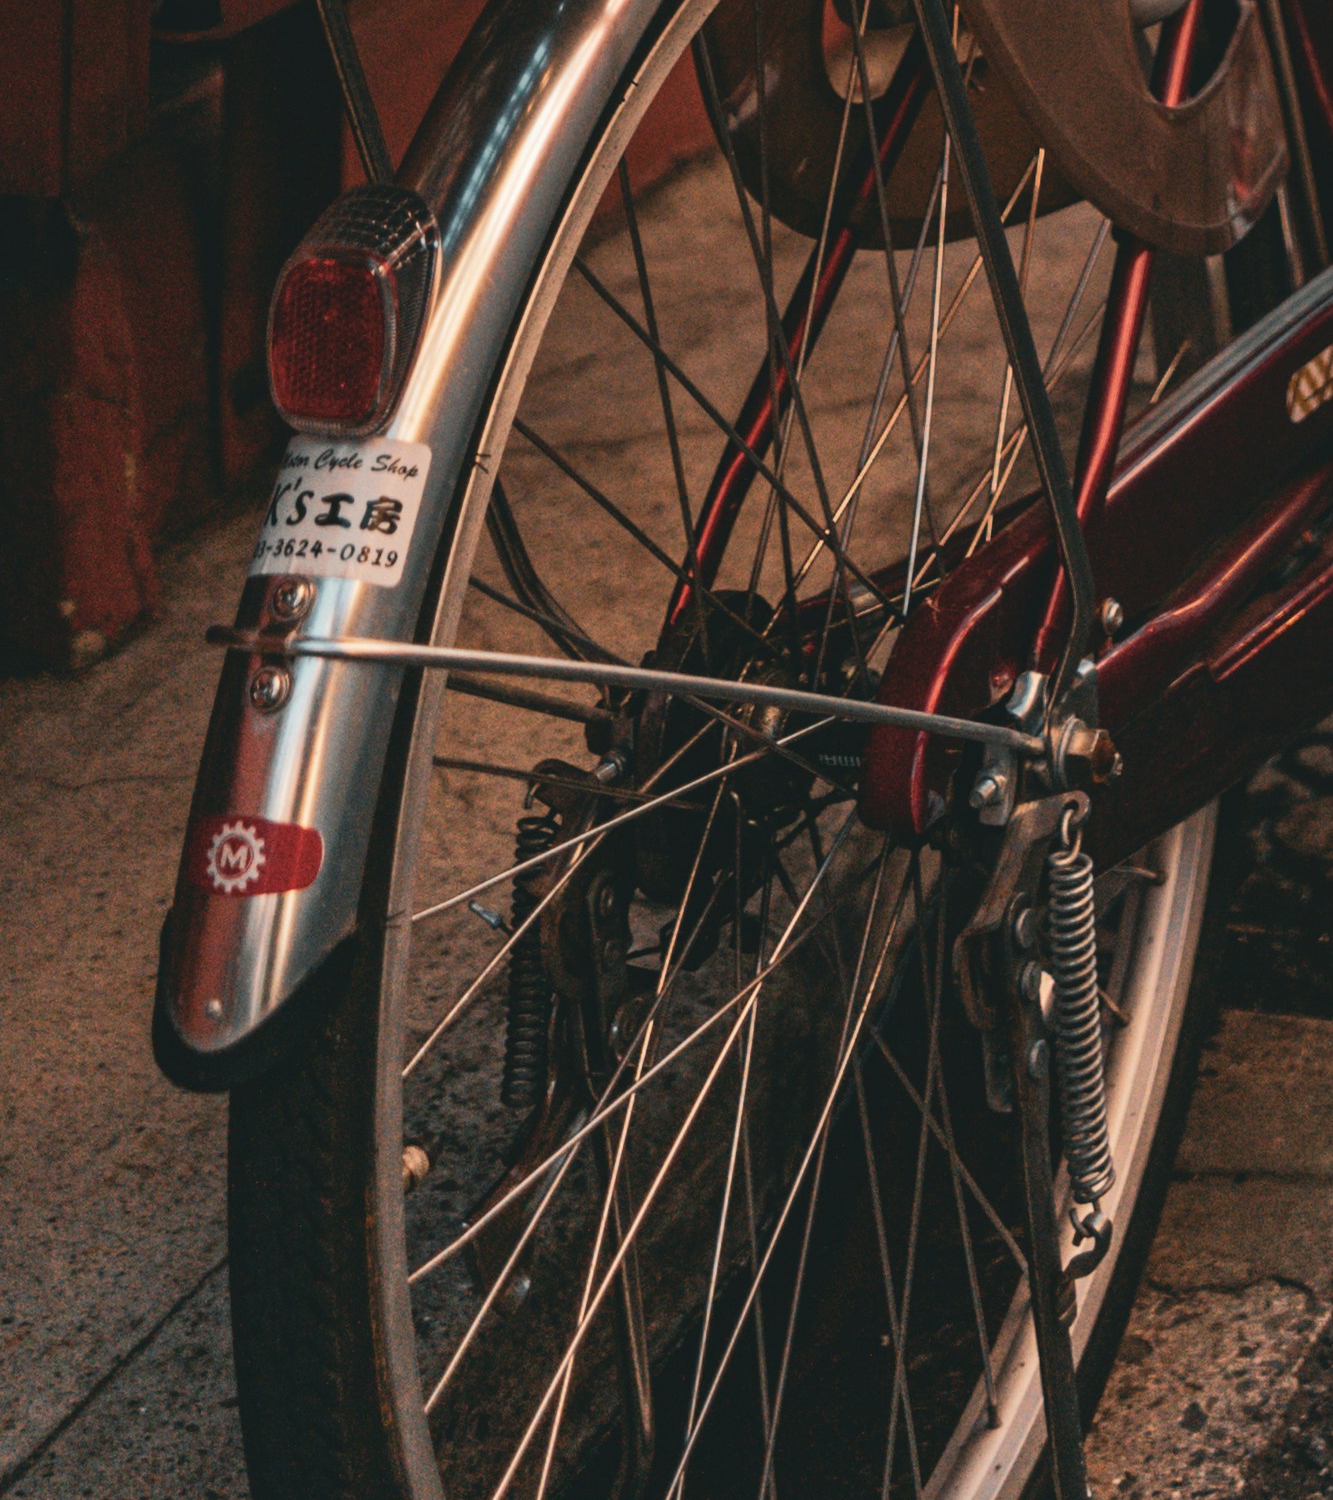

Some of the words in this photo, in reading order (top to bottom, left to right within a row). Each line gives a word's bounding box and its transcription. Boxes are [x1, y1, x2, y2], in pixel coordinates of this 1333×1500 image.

[313, 448, 364, 473] Cycle
[370, 454, 419, 481] Shop
[221, 843, 248, 869] M
